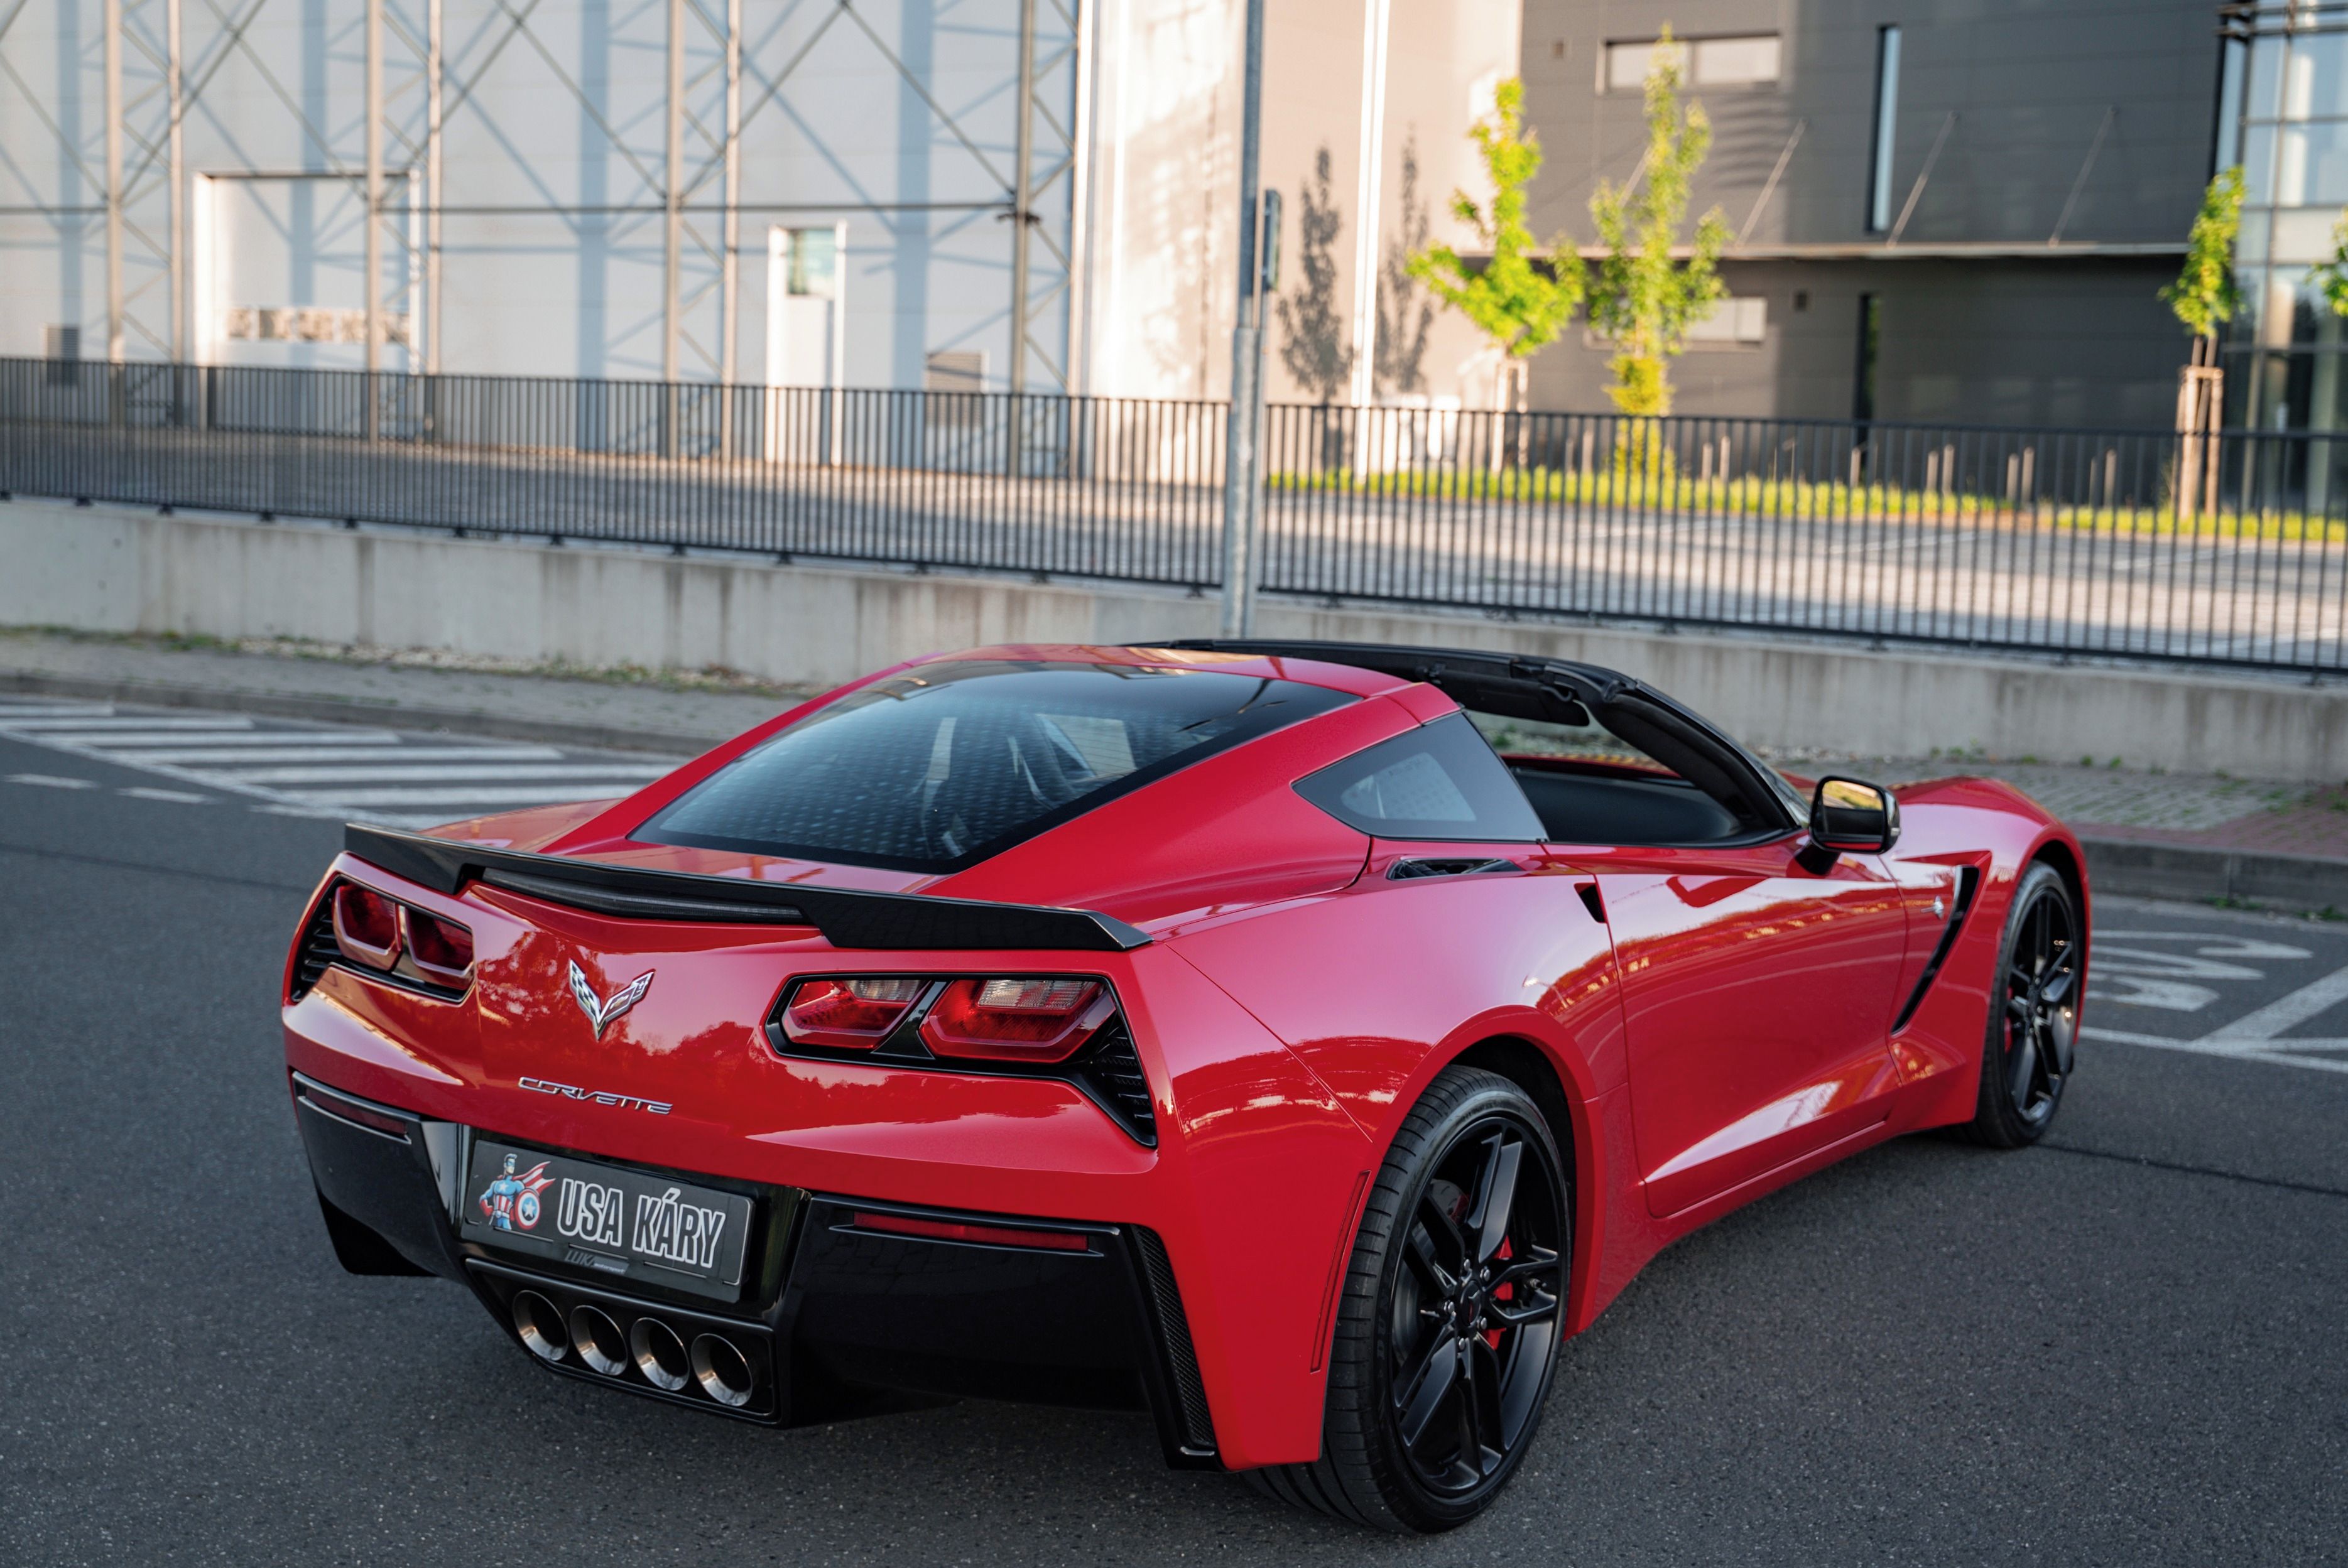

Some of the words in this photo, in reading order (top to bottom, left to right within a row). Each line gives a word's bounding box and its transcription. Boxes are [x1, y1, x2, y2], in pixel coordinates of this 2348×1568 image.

[518, 1076, 673, 1114] CORVETTE
[557, 1178, 623, 1246] USA
[632, 1187, 726, 1268] KÁRY
